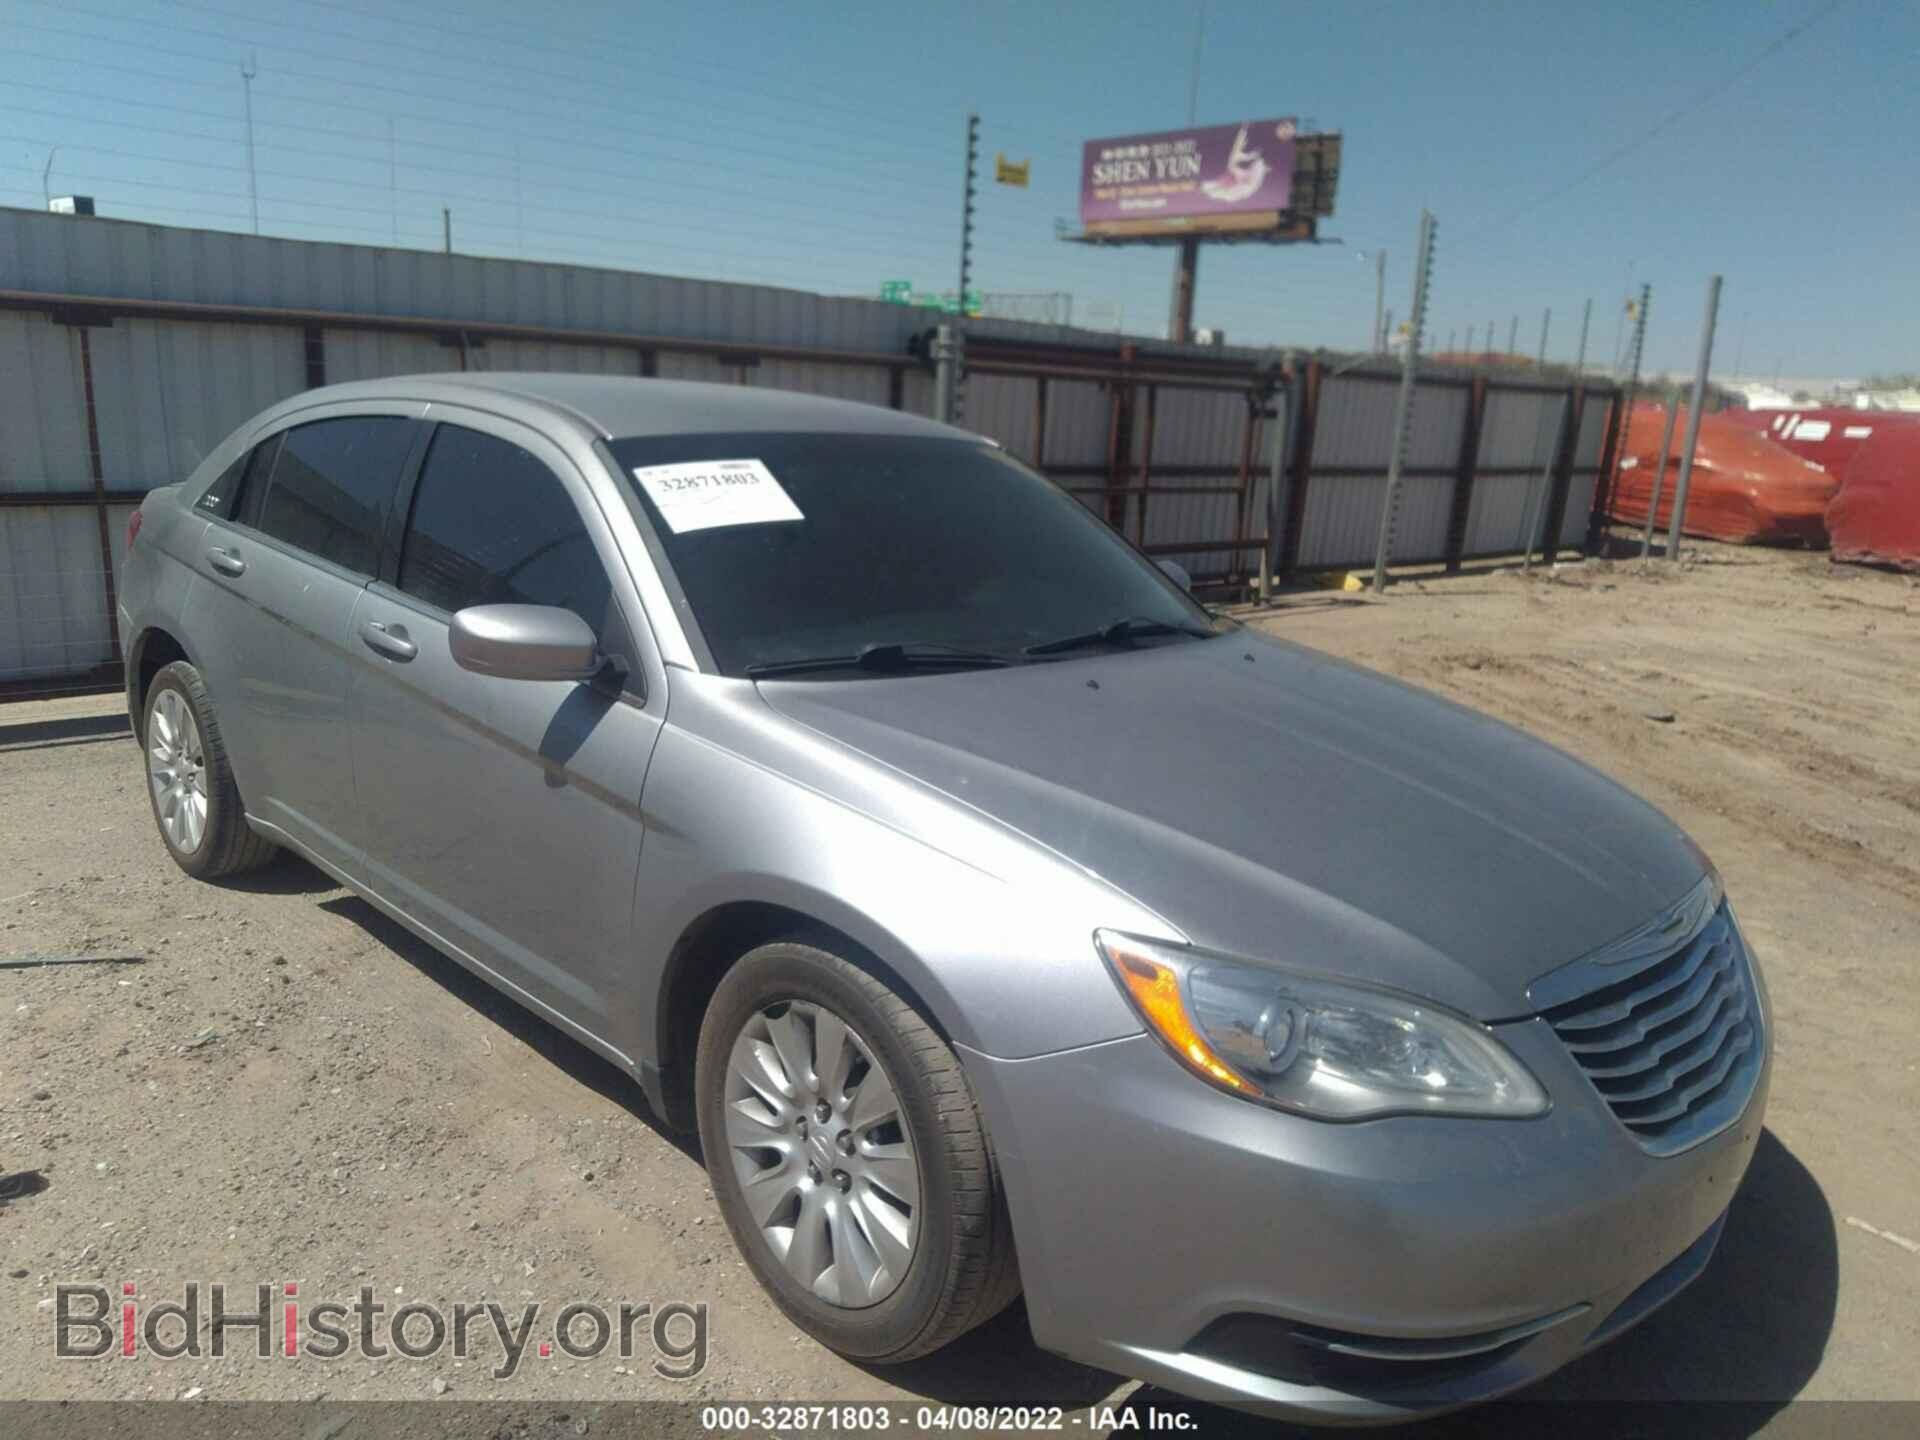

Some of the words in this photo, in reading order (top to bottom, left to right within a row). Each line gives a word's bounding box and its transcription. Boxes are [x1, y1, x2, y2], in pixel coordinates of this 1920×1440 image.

[1092, 160, 1150, 184] SHEN
[1154, 152, 1202, 178] YUN
[658, 473, 761, 492] 32871803
